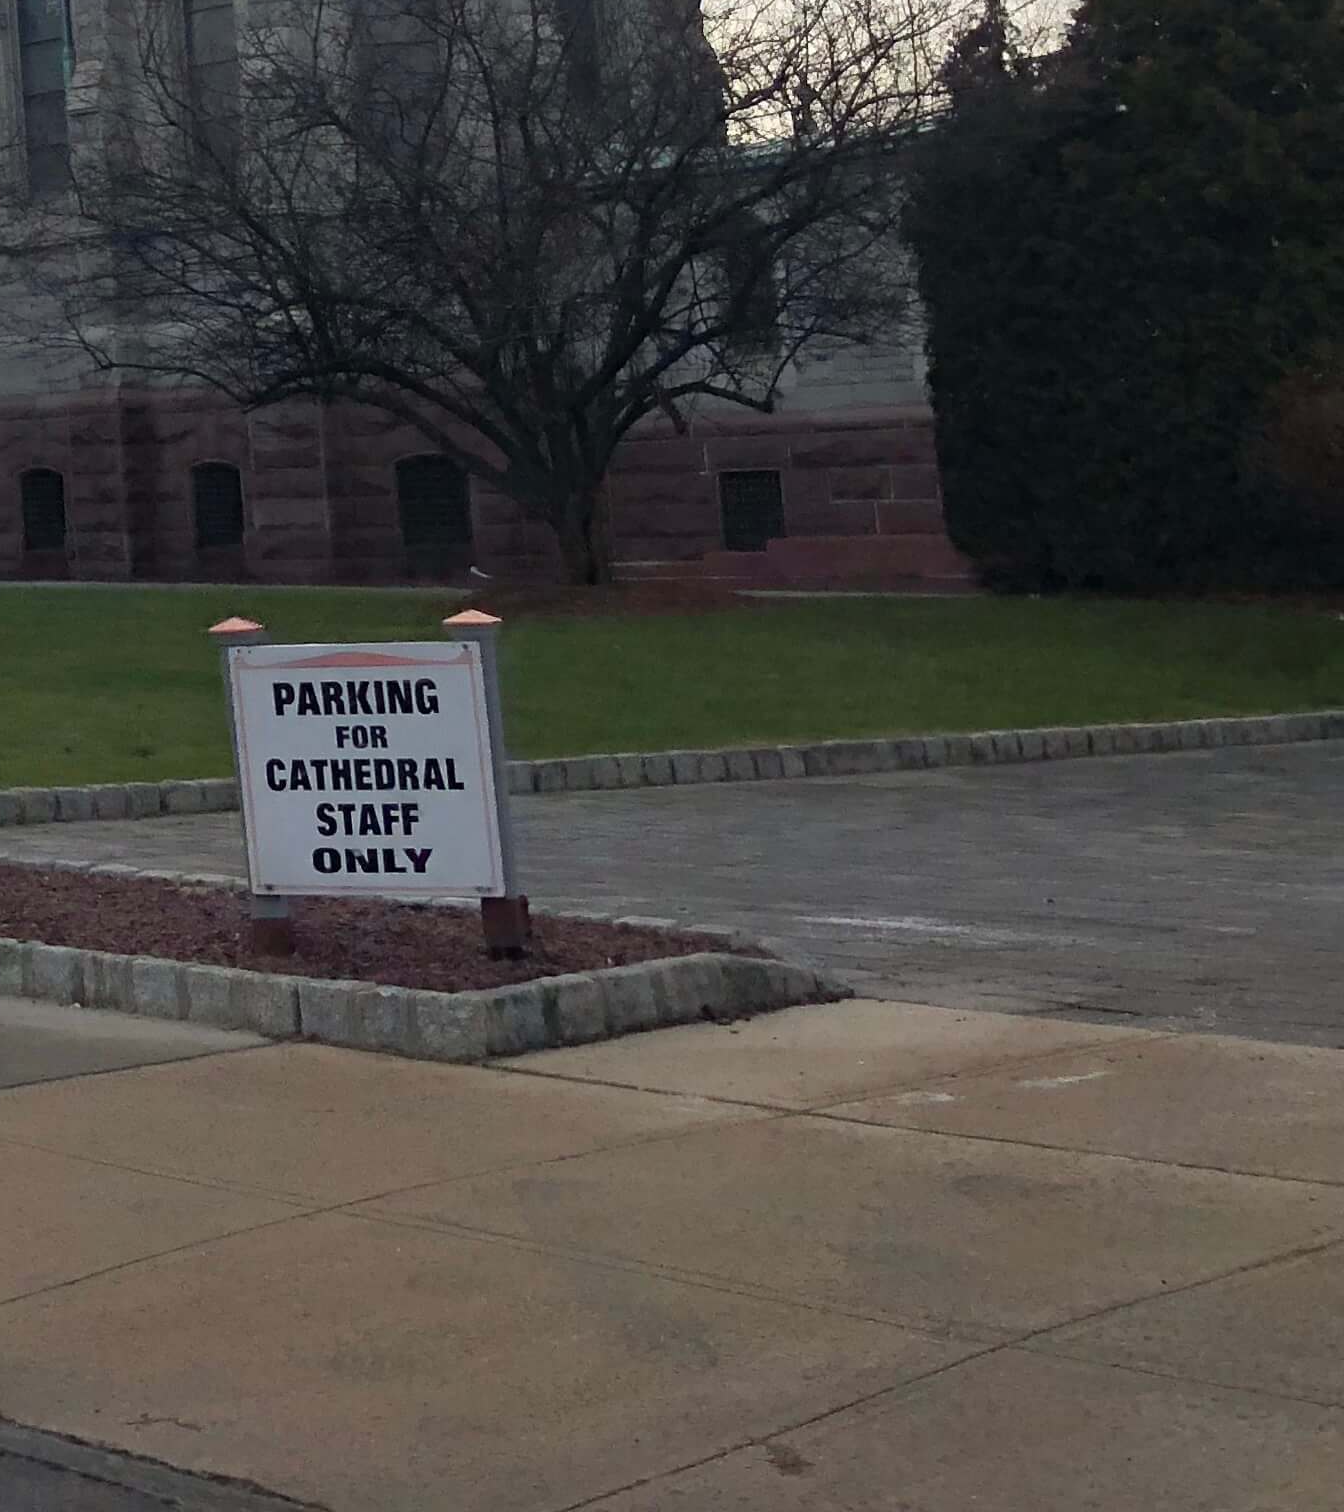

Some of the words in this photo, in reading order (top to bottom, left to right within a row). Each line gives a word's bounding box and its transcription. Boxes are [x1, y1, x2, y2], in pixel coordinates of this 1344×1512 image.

[272, 678, 440, 716] PARKING
[335, 725, 388, 749] FOR
[266, 757, 465, 792] CATHEDRAL
[316, 803, 419, 837] STAFF
[312, 847, 434, 874] ONLY
